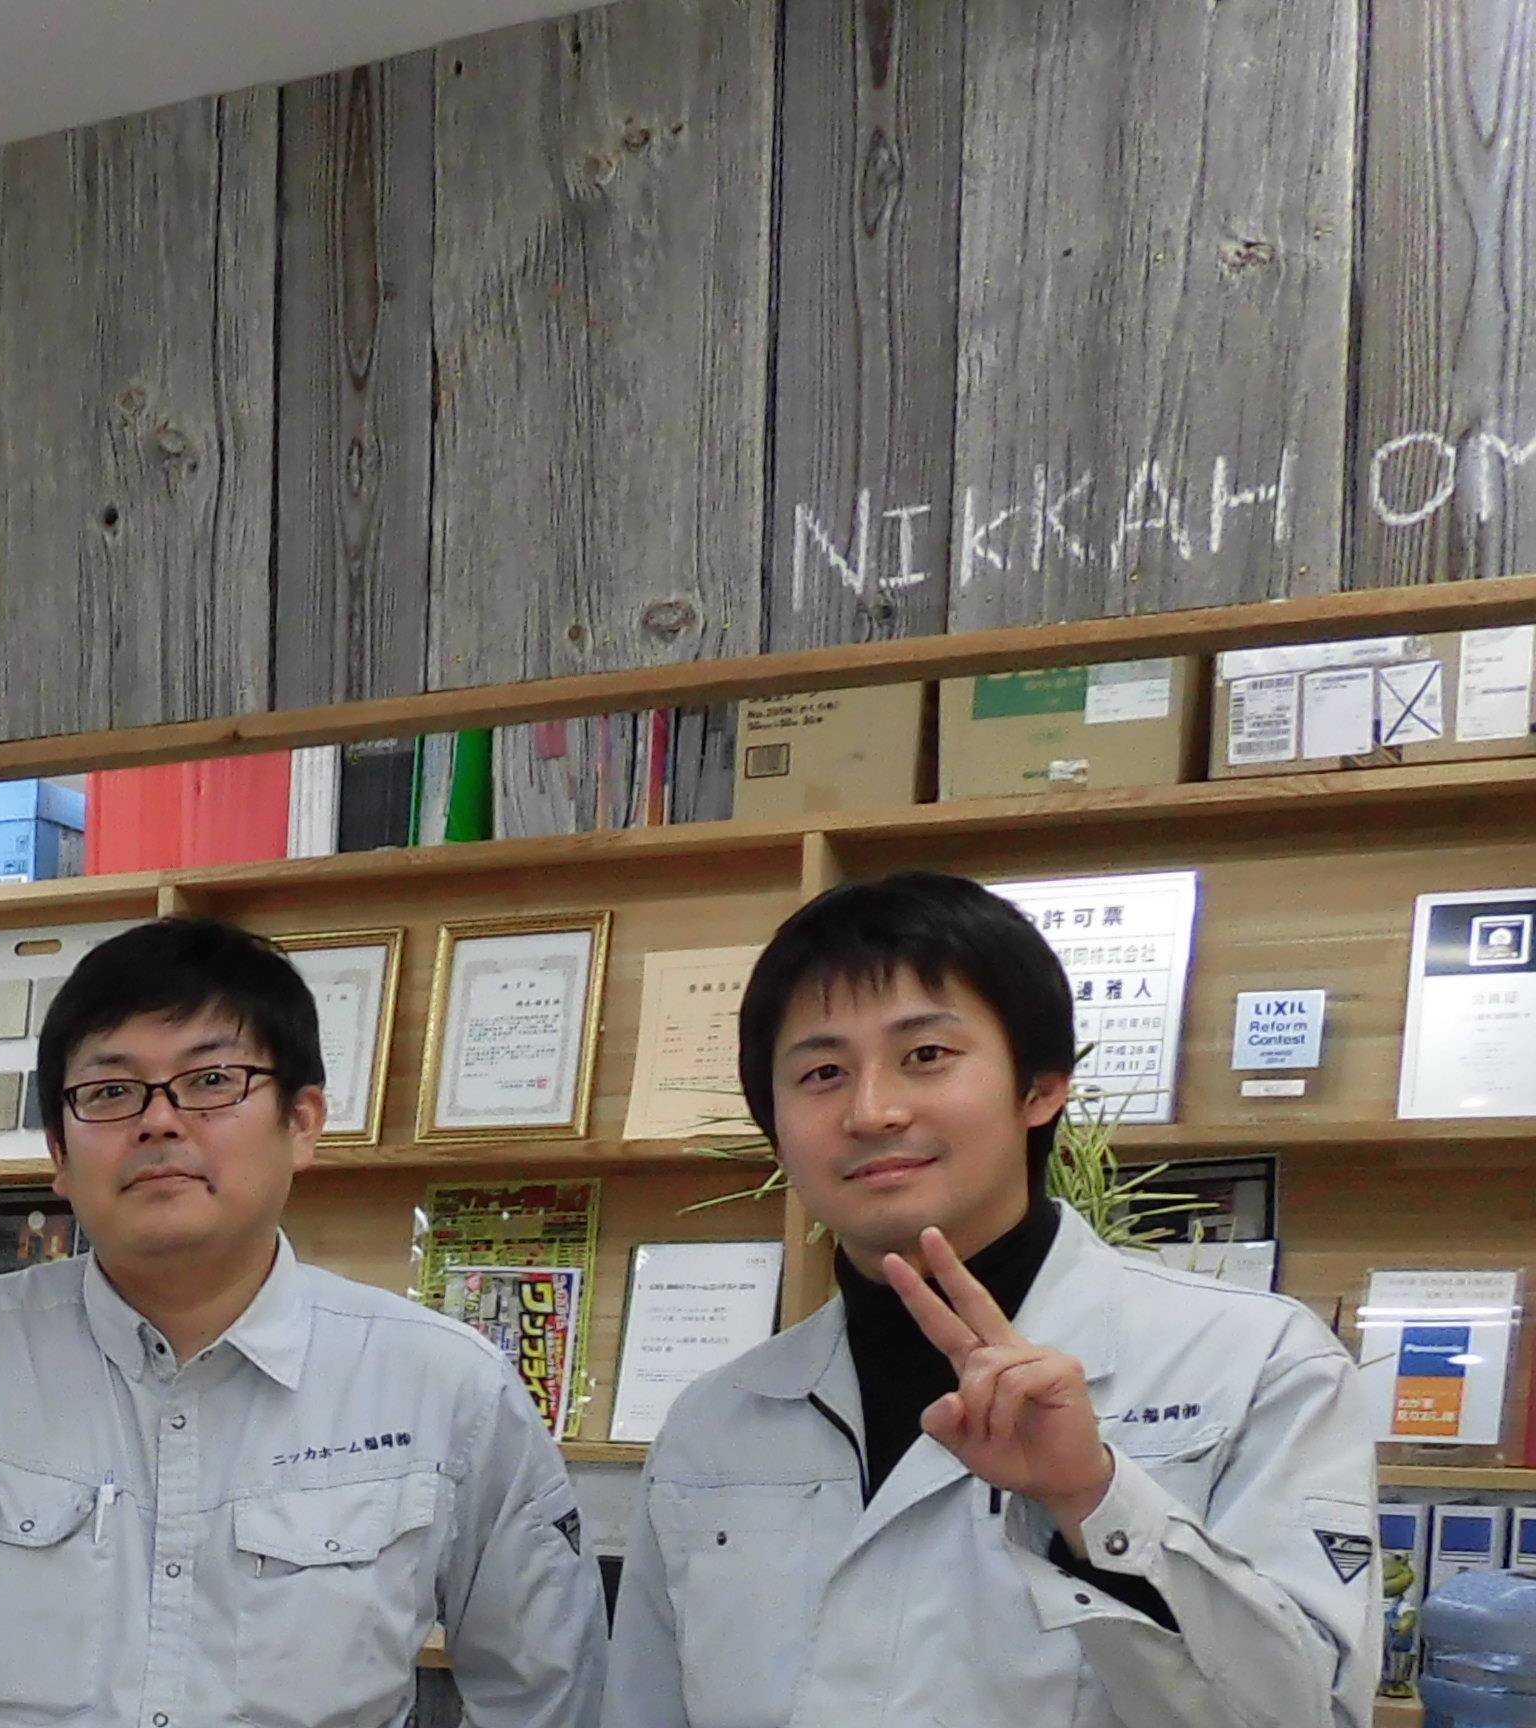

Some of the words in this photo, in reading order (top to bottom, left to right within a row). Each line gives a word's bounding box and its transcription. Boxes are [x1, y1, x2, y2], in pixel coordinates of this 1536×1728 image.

[791, 447, 1300, 613] NIKKAH
[1254, 1000, 1306, 1016] LIXIL
[1249, 1020, 1308, 1032] Reform
[1248, 1034, 1306, 1046] Contest
